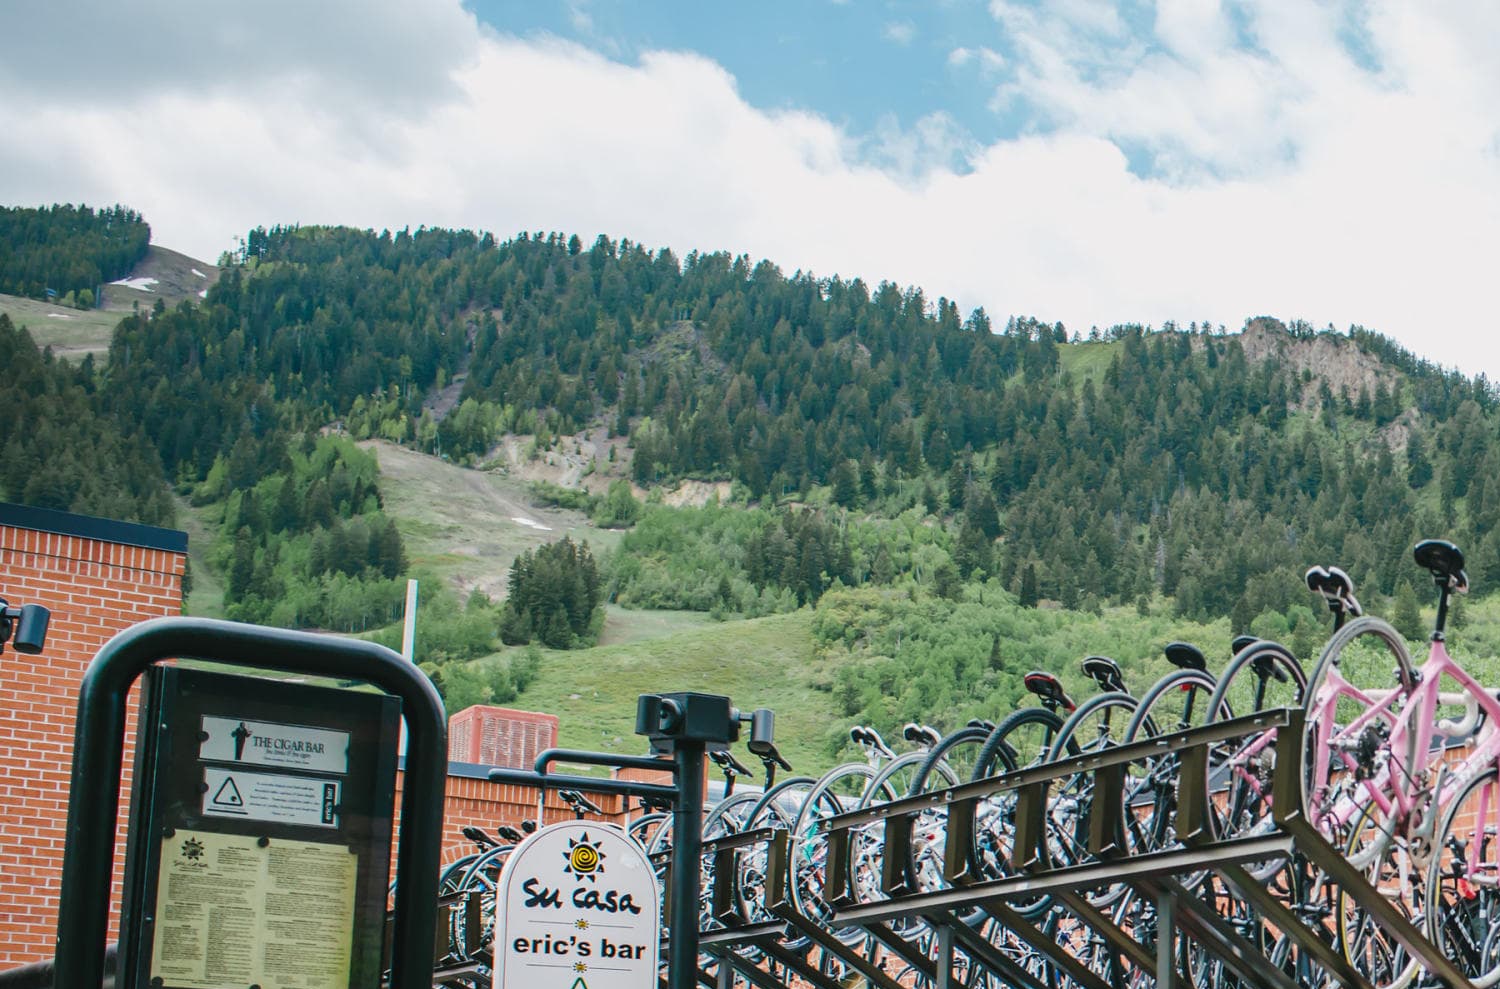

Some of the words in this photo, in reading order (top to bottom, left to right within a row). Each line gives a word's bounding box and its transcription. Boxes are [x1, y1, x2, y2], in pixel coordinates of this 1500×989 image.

[253, 735, 272, 749] THE
[274, 738, 304, 752] CIGAR
[305, 742, 325, 754] BAR
[522, 877, 563, 909] Su
[572, 887, 641, 915] casa
[513, 934, 592, 957] eric's
[601, 938, 646, 960] bar
